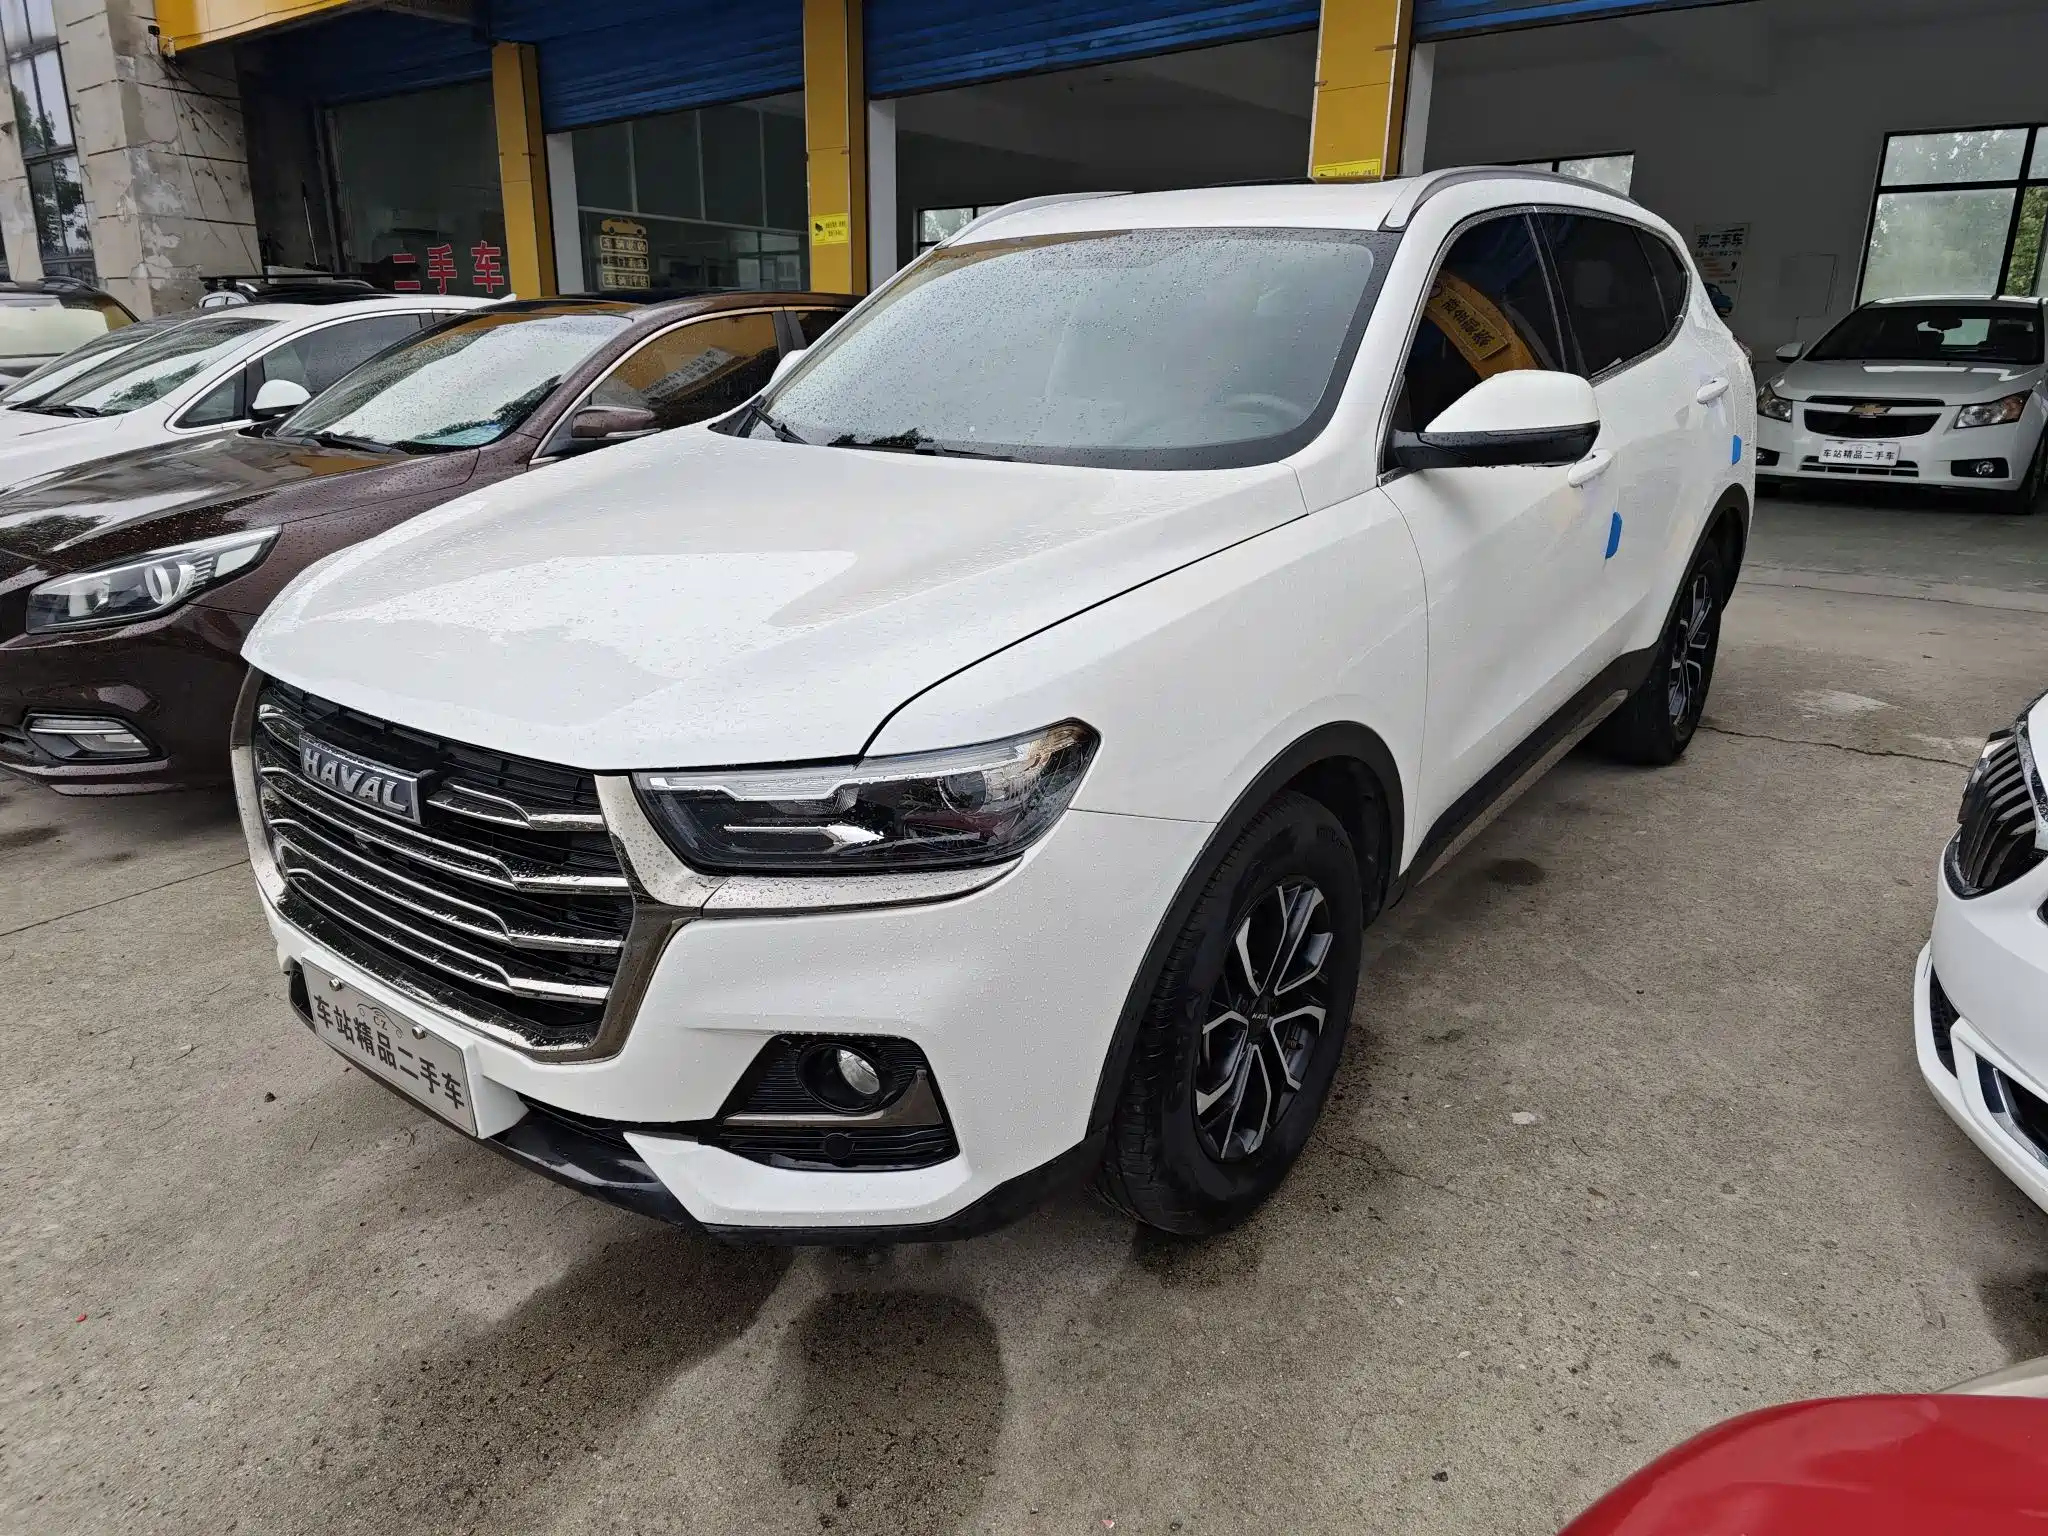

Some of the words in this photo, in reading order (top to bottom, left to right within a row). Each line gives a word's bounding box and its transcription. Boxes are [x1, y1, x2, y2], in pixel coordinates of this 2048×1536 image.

[393, 240, 504, 295] 二手车
[1823, 448, 1896, 461] 车站精品二手车
[303, 747, 408, 812] HAVAL
[313, 994, 465, 1110] 车站精品二手车
